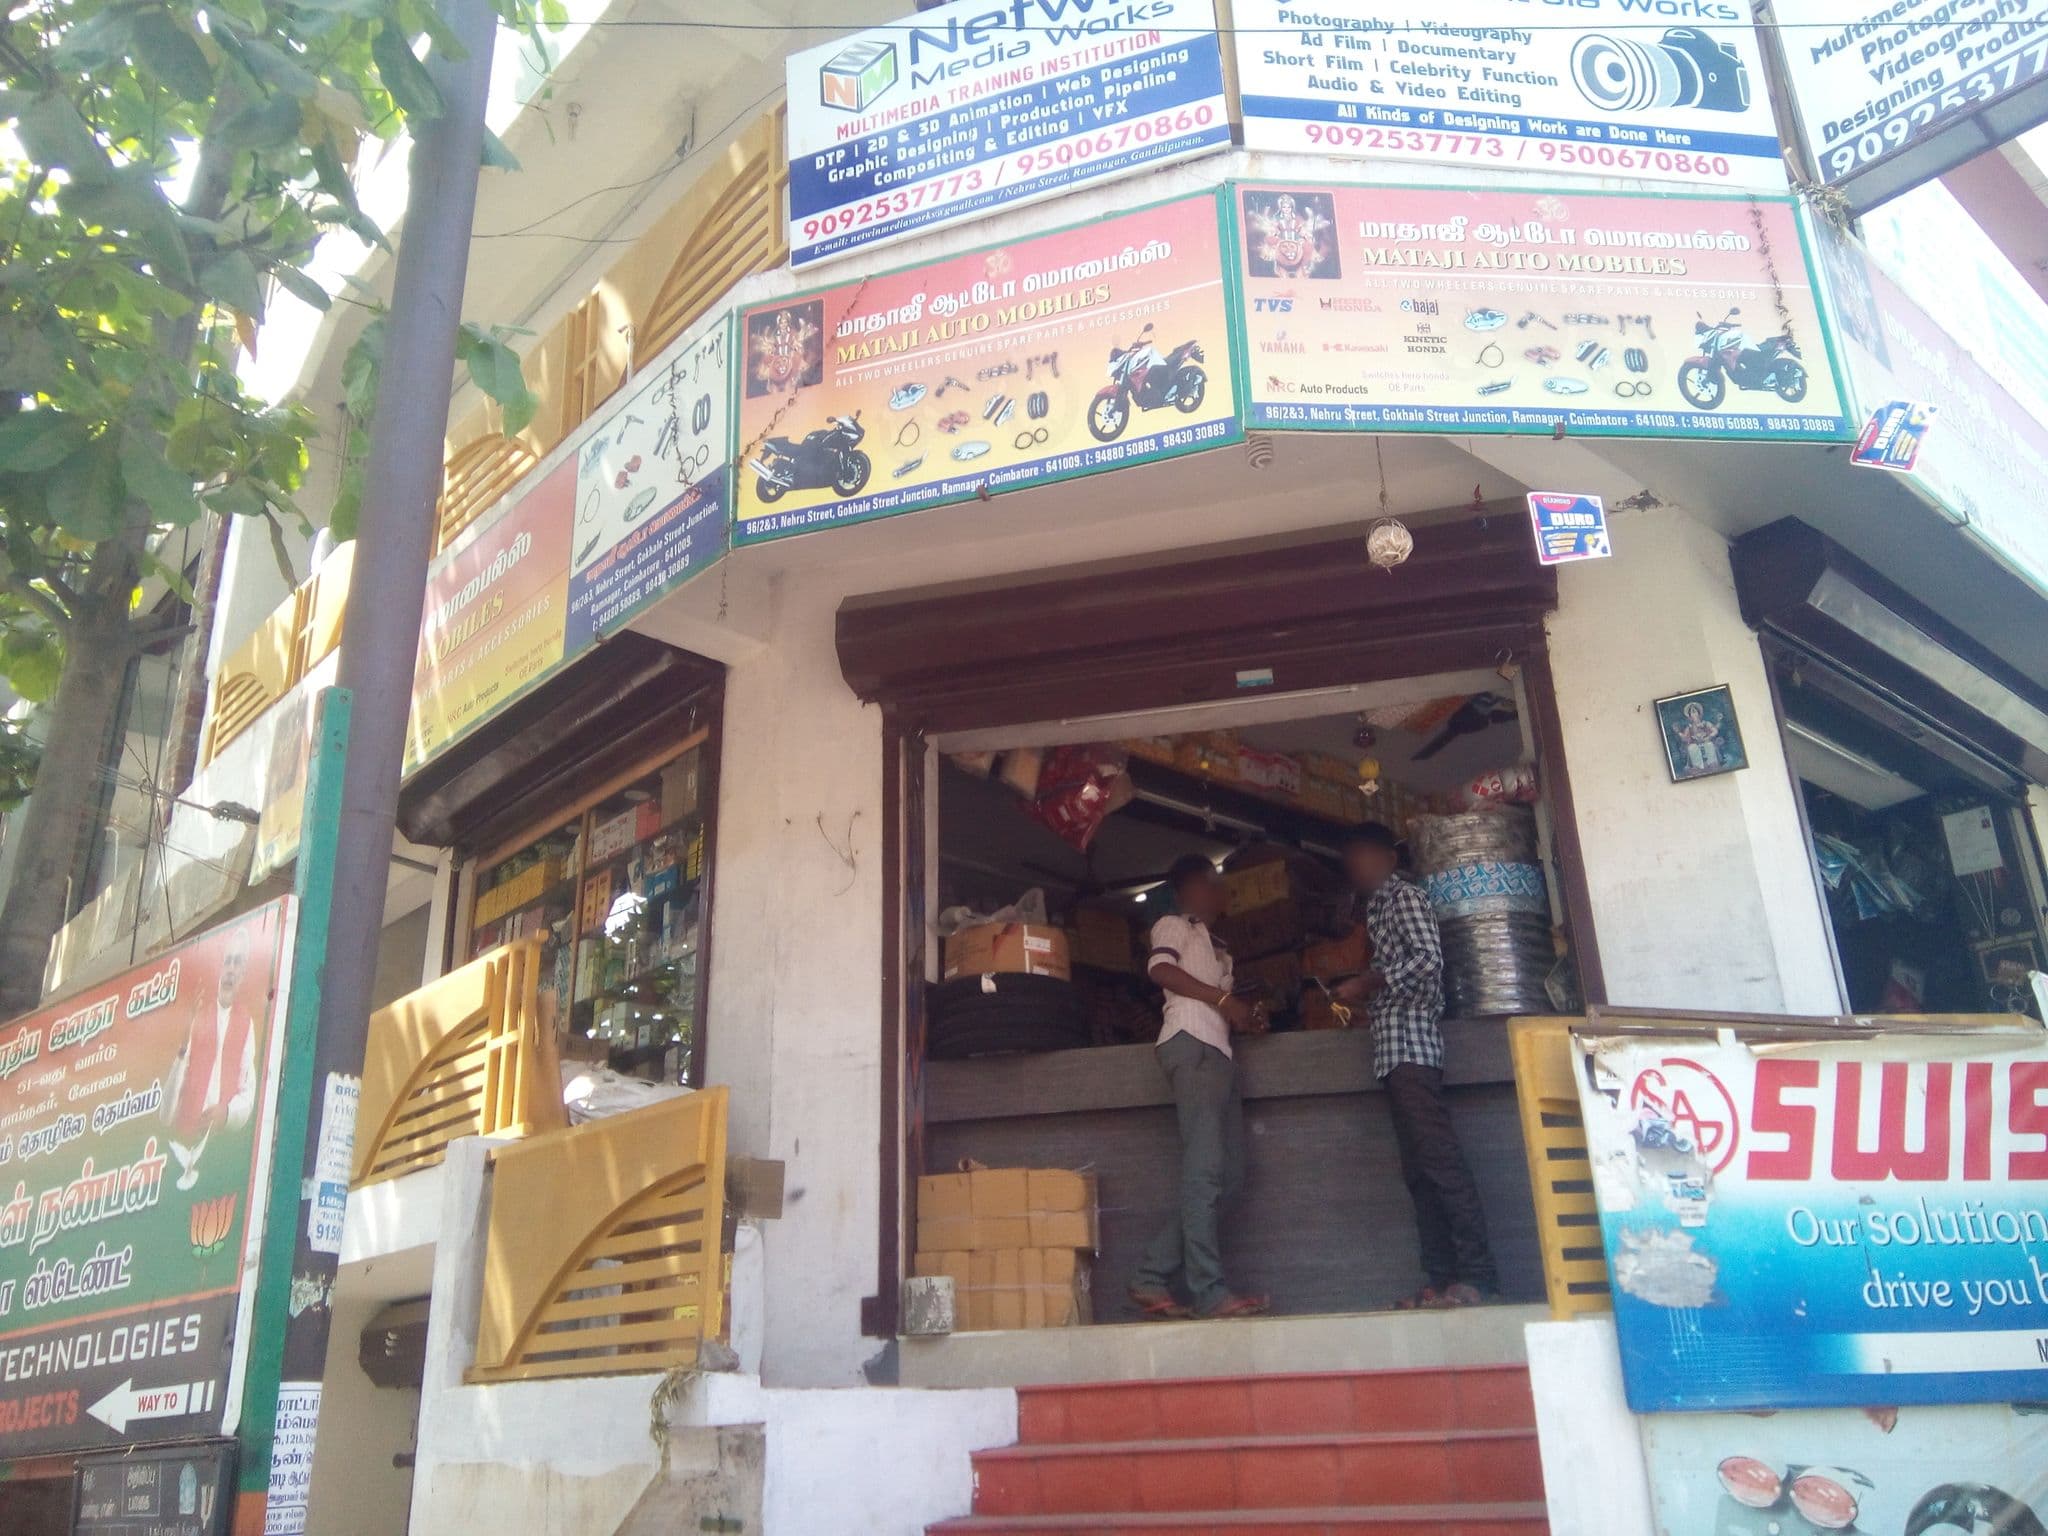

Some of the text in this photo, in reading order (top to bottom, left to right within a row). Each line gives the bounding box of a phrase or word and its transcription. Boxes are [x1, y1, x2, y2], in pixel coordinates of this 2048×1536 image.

[911, 1, 1174, 90] Media Works
[1278, 9, 1532, 45] Photography Videography
[1300, 31, 1517, 64] Ad Film Documentary
[836, 29, 1161, 140] MULTIMEDIA TRAINING INSTITUTION
[1263, 50, 1558, 87] Short Film Celebrity Function
[815, 48, 1189, 170] DTP 2D & 3D Animation Web Designing
[1308, 75, 1522, 108] Audio & Video Editing
[1821, 67, 1944, 144] Designing
[828, 69, 1177, 183] Graphic Designing Production Pipeline
[1337, 103, 1692, 145] All Kinds of Designing Work are Done Here
[874, 100, 1129, 187] Compositing & Editing VFX
[1305, 123, 1730, 176] 9092537773 9500670860
[803, 104, 1214, 241] 9092537773 9500670860
[1362, 247, 1688, 276] MATAJI AUTO MOBILES
[1425, 279, 1495, 291] WHEELERS
[835, 283, 1111, 365] MATAJI AUTO MOBILES
[1254, 298, 1293, 313] TVS
[1412, 298, 1440, 316] bajaj
[1260, 341, 1306, 354] YAMAHA
[1407, 345, 1446, 354] HONDA
[857, 369, 881, 382] TWO
[883, 354, 941, 377] WHEELERS
[1300, 383, 1323, 394] Auto
[1325, 383, 1369, 395] Products
[1310, 408, 1342, 421] Nehru
[1344, 408, 1381, 422] Street,
[1382, 409, 1425, 422] Gokhale
[1427, 410, 1460, 423] Street
[1462, 410, 1511, 425] Junction,
[1569, 412, 1629, 427] Coimbatore
[780, 512, 806, 528] Nehru
[807, 506, 835, 523] Street,
[837, 500, 872, 518] Gokhale
[872, 494, 900, 510] Street
[900, 486, 940, 504] Junction,
[989, 465, 1039, 486] Coimbatore
[1787, 1196, 2048, 1247] Our solution
[1862, 1268, 1954, 1309] drive
[1961, 1279, 2032, 1316] you
[137, 1391, 178, 1414] WAY TO
